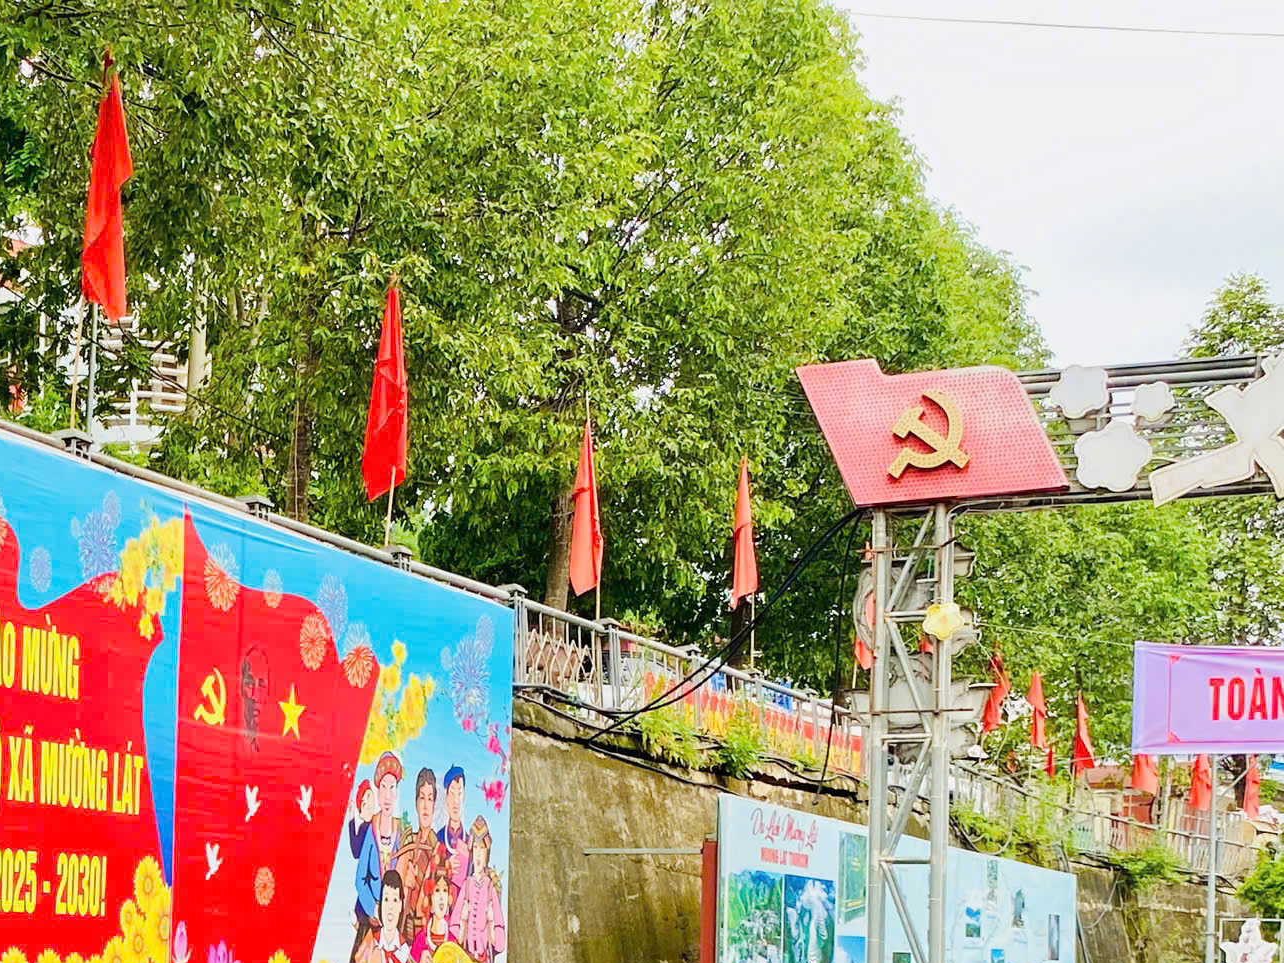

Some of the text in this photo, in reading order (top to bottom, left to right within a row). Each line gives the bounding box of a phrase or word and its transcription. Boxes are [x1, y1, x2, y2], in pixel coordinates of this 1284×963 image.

[21, 613, 80, 700] MỪNG
[7, 725, 34, 803] XÃ
[40, 728, 108, 811] MƯỜNG
[112, 741, 144, 815] LÁT
[43, 880, 51, 893] -
[55, 853, 107, 917] 2030!
